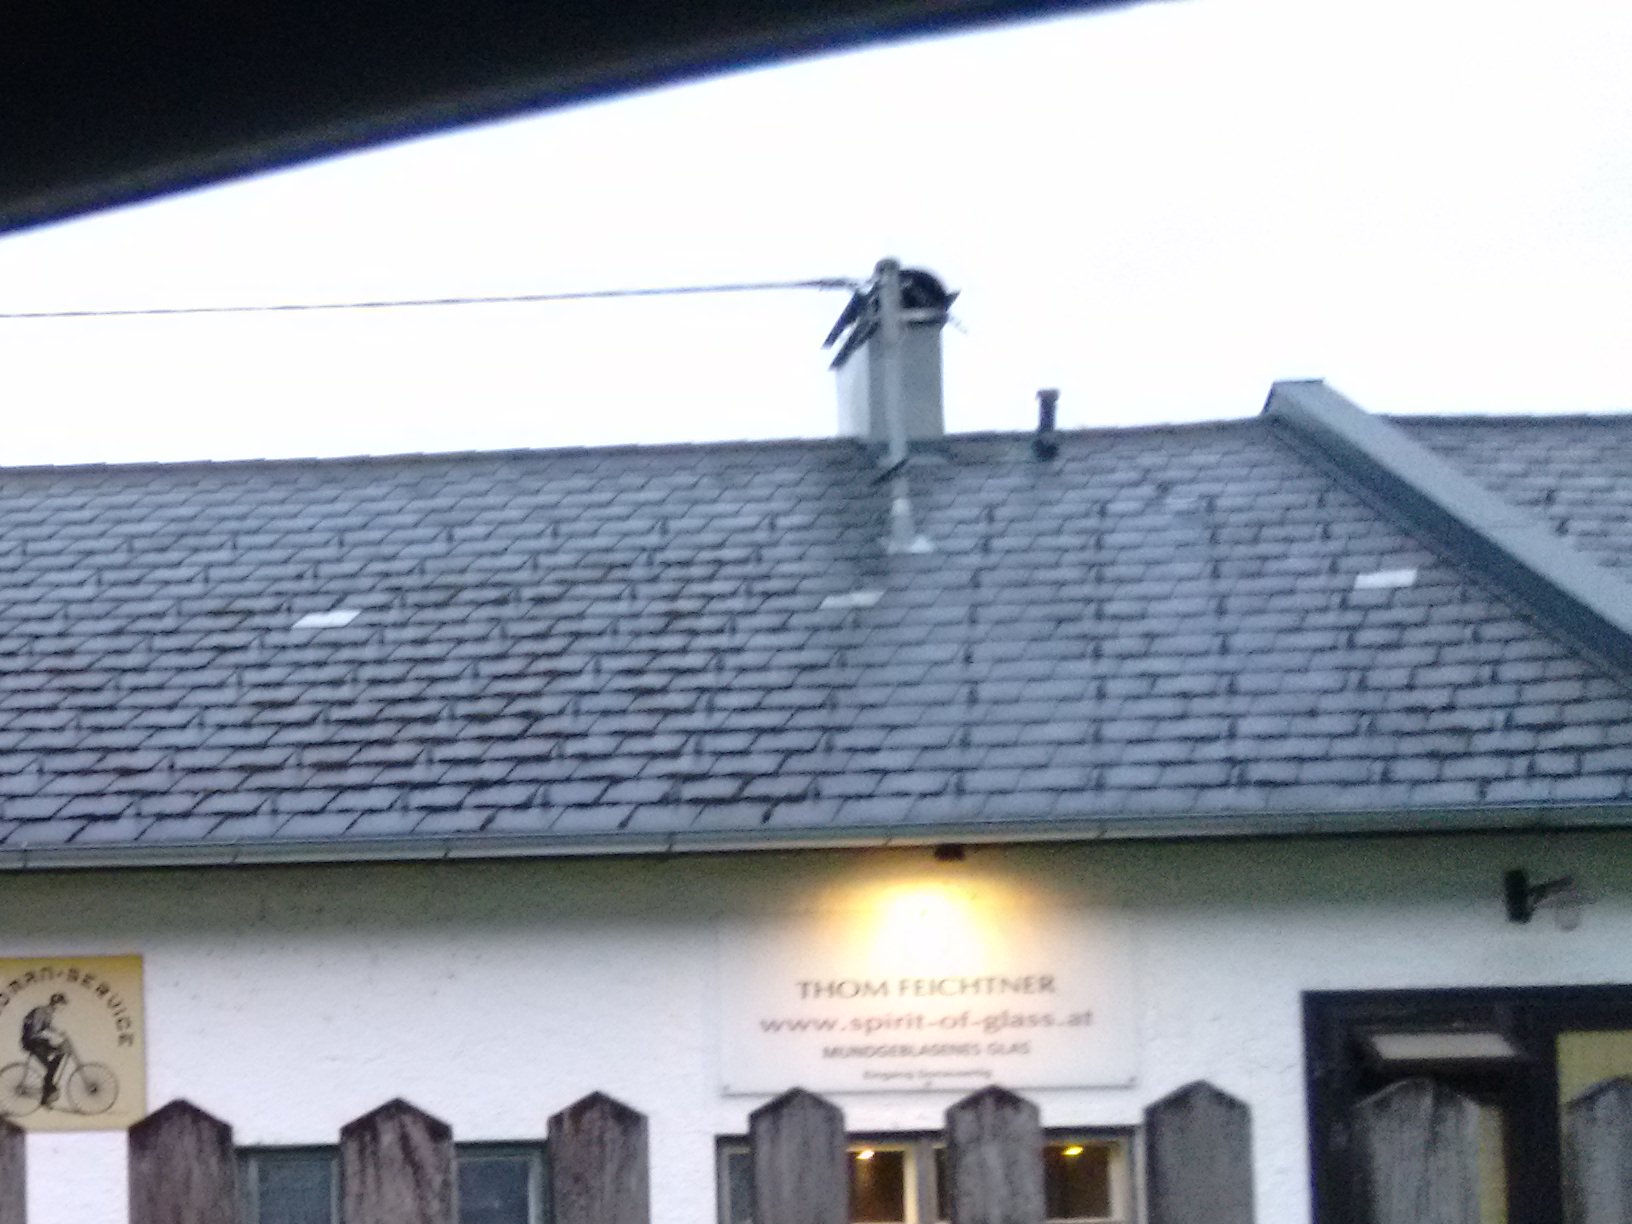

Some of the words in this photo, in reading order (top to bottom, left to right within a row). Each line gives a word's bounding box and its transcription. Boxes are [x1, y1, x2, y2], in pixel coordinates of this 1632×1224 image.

[796, 979, 888, 1000] THOM
[898, 974, 1057, 997] FEICHTNER
[759, 1008, 1094, 1034] www.spirit-of-glass.at
[986, 1040, 1032, 1056] GLAS
